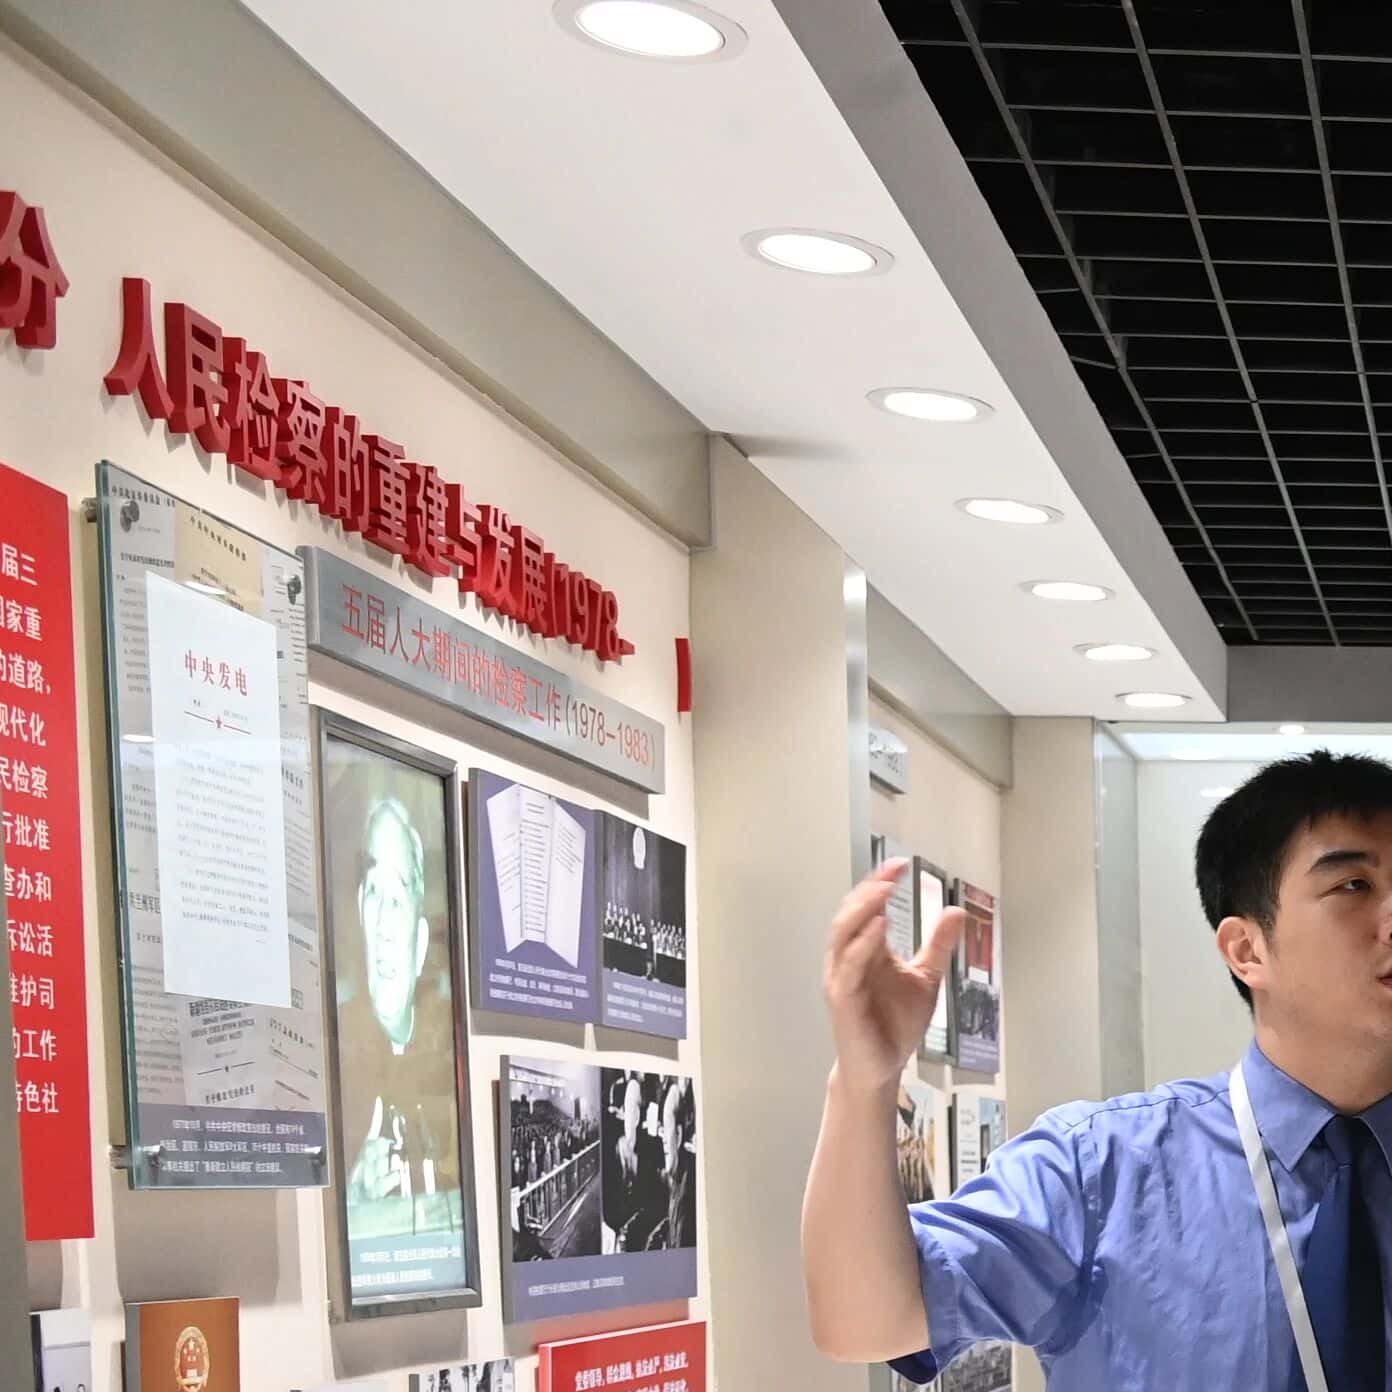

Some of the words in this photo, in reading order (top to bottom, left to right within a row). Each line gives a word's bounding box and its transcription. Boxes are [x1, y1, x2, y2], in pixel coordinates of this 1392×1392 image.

[0, 596, 43, 642] 家重
[184, 649, 249, 697] 中央发电
